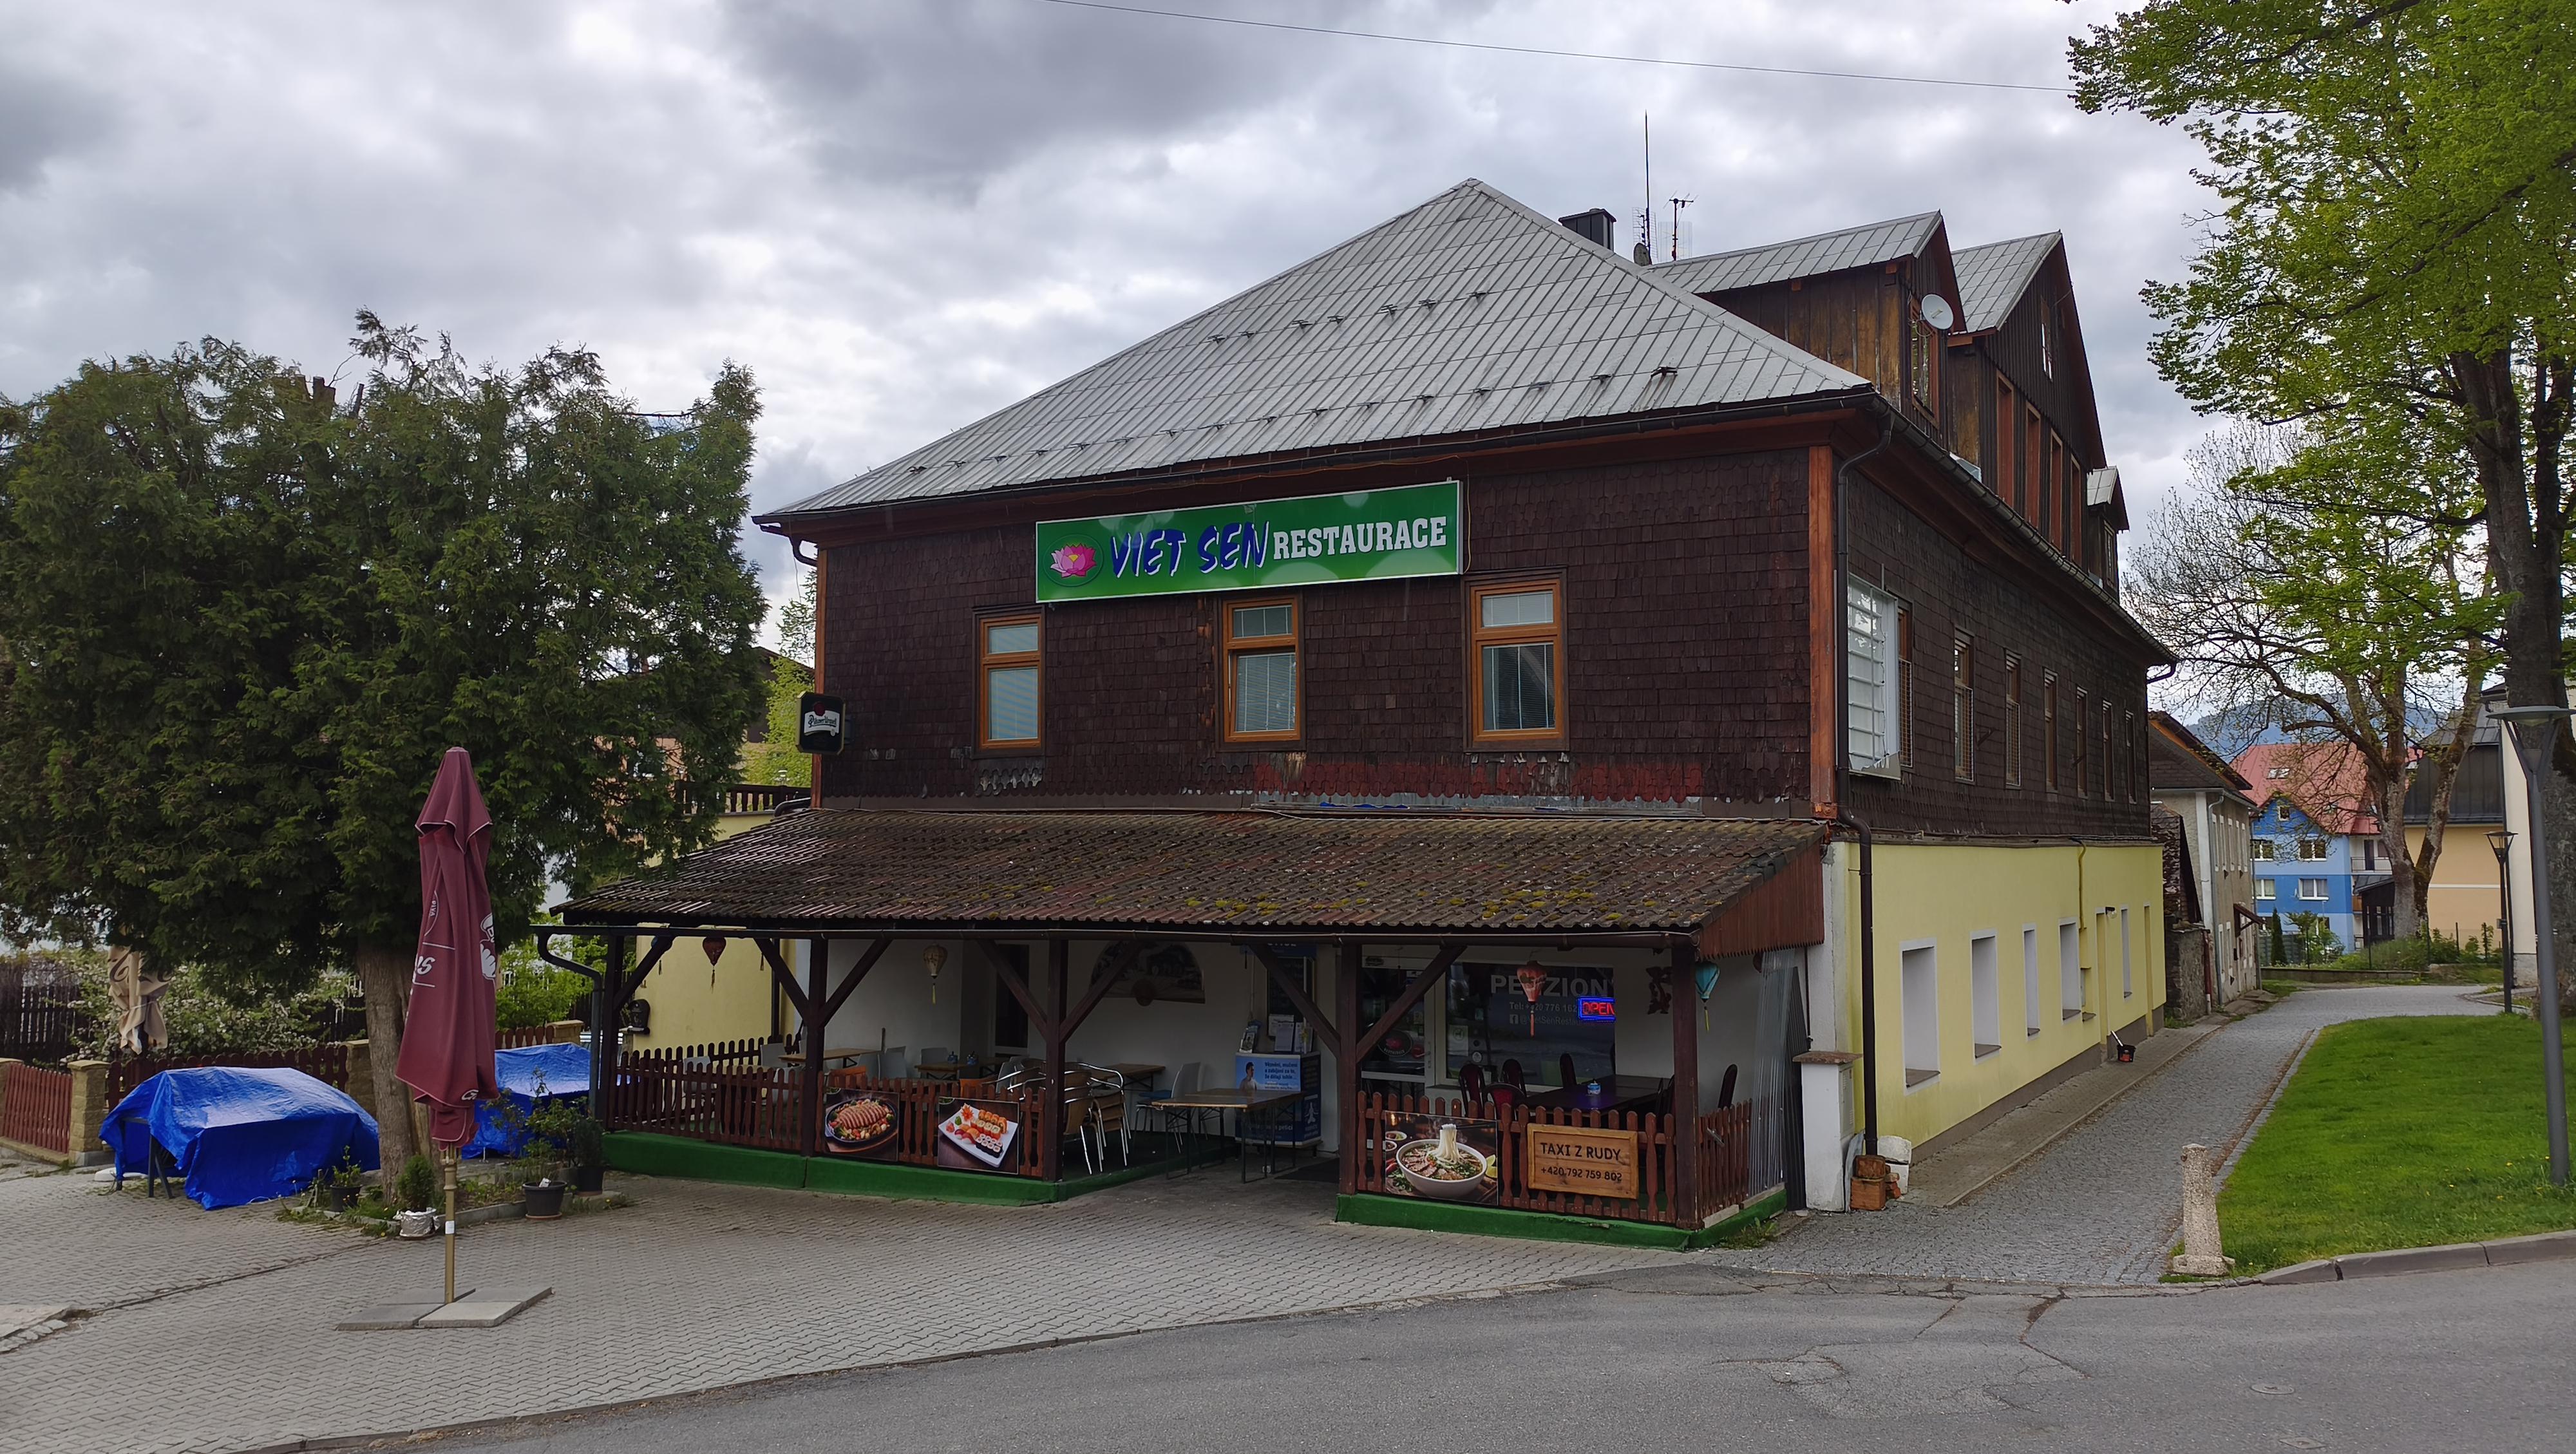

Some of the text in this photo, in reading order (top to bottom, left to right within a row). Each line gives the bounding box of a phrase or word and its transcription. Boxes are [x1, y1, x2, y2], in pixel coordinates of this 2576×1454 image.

[1110, 516, 1447, 578] VIET SEN RESTAURACE
[1490, 974, 1608, 997] PEZION
[1582, 1002, 1615, 1016] OPEN
[1540, 1142, 1621, 1160] TAXI Z RUDY
[1541, 1166, 1622, 1182] +420 792 759 802
